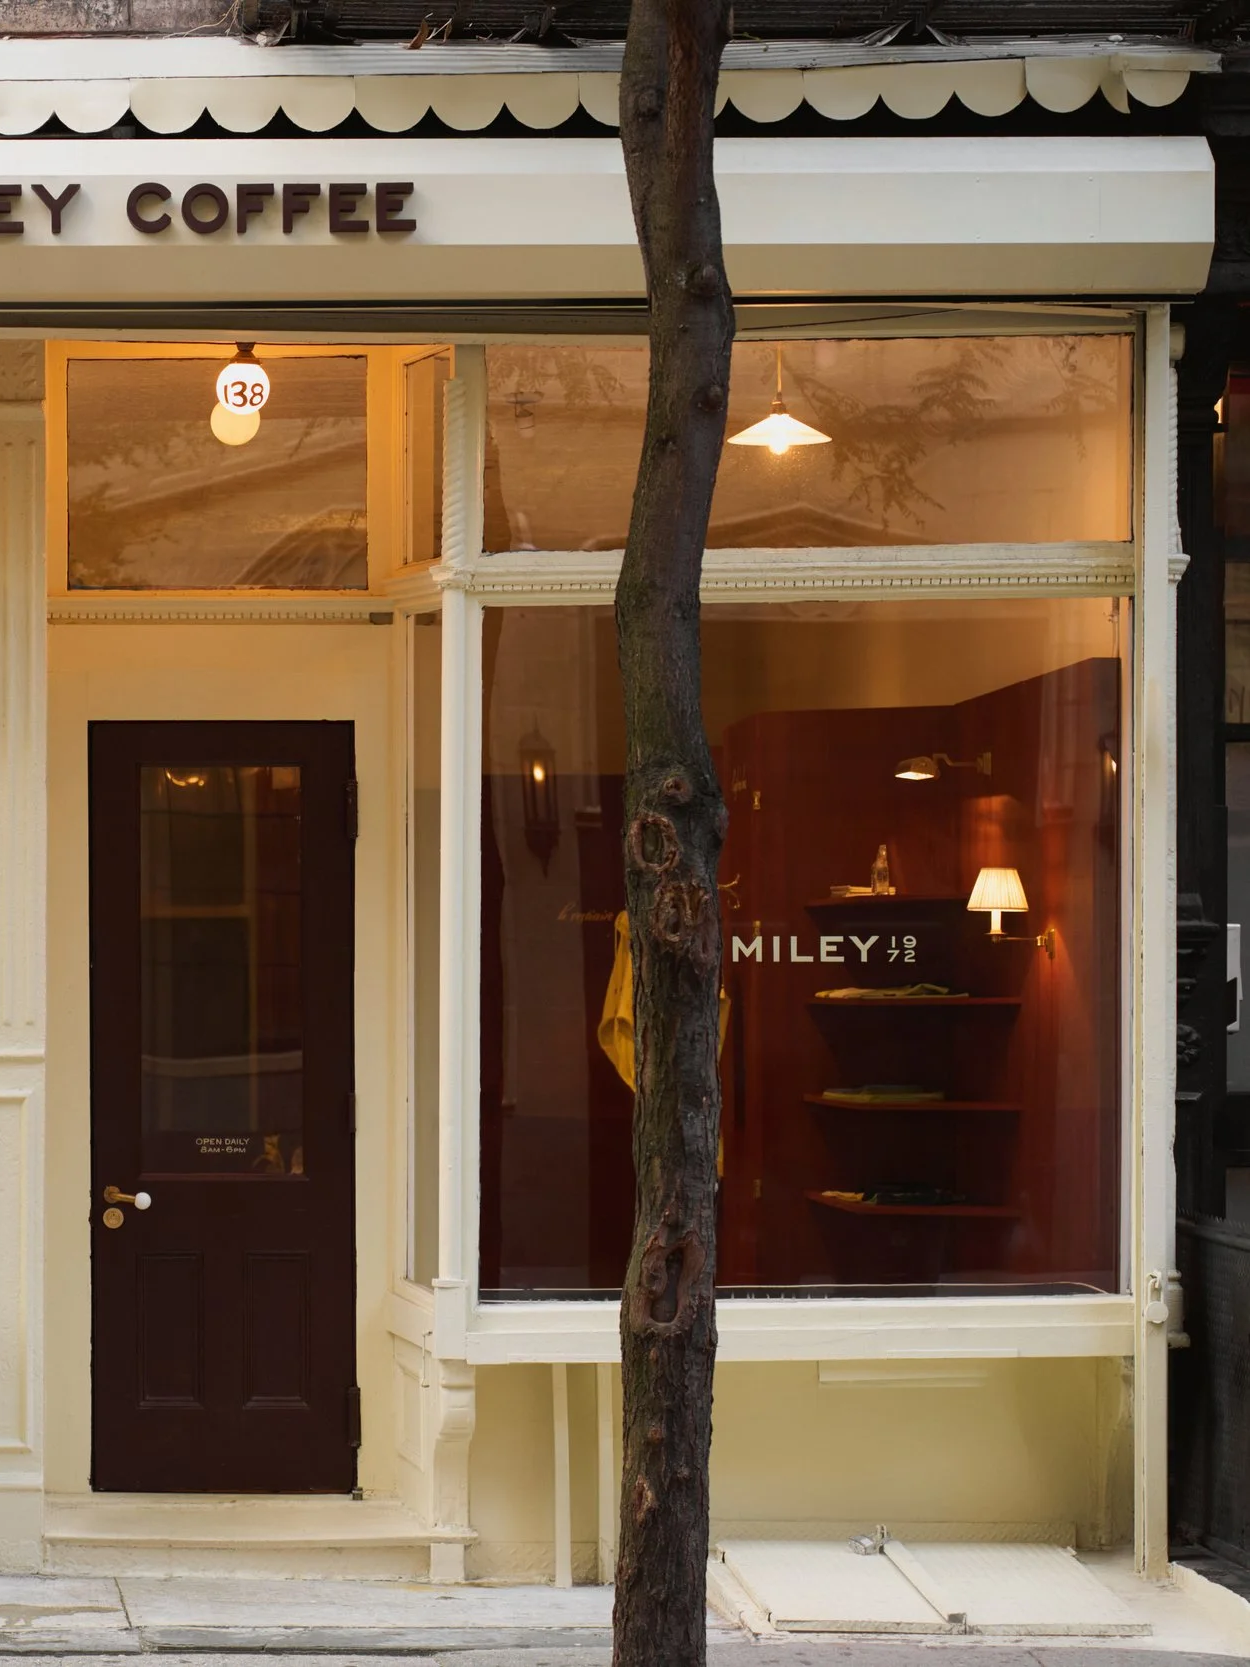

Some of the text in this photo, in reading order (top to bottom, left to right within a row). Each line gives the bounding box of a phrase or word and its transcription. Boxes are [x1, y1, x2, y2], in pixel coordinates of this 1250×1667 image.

[126, 181, 417, 235] COFFEE
[223, 380, 264, 408] 138
[732, 935, 880, 963] MILEY
[195, 1138, 250, 1146] OPEN DAILY
